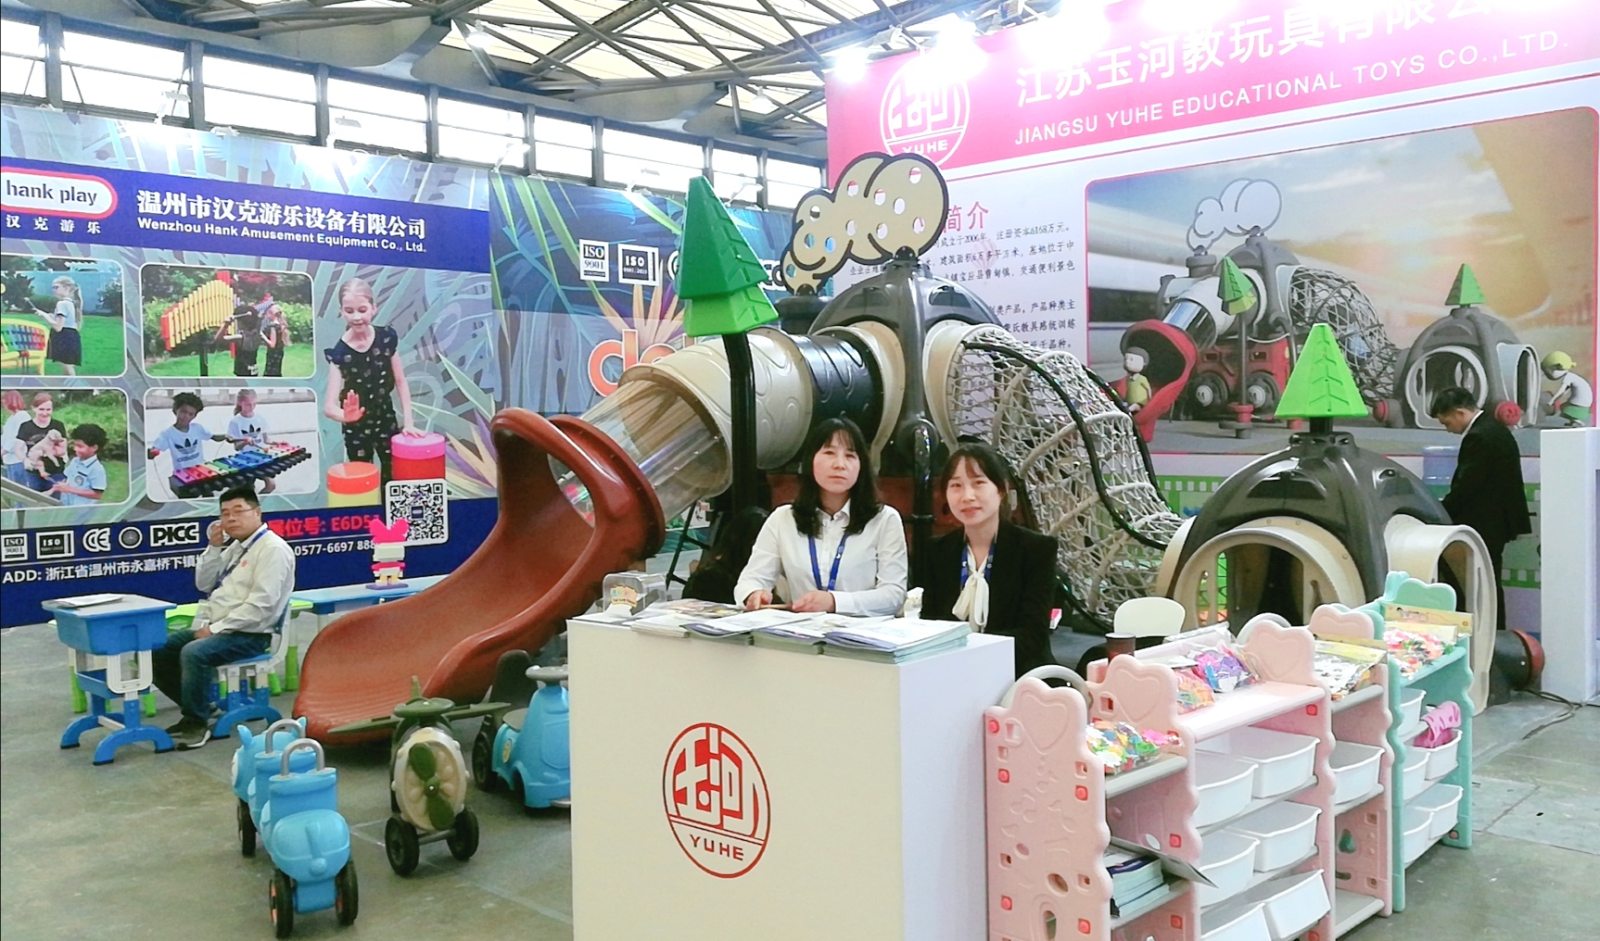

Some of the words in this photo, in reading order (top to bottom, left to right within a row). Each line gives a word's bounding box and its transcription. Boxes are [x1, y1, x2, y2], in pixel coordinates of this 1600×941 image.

[1015, 115, 1099, 146] JIANGSU
[1106, 103, 1164, 129] YUHE
[1172, 73, 1342, 116] EDUCATIONAL
[1353, 55, 1426, 85] TOYS
[6, 180, 55, 200] hank
[60, 185, 98, 206] play
[136, 189, 427, 240] 温州市汉克游乐设备有限公司
[6, 214, 102, 235] 汉克游乐
[137, 217, 202, 234] Wenzhou
[204, 223, 239, 237] Hank
[241, 226, 315, 244] Amusement
[317, 233, 379, 249] Equipment
[405, 241, 428, 253] Ltd.
[584, 245, 605, 259] ISO
[625, 255, 645, 267] ISO
[331, 514, 380, 532] E6D5
[5, 537, 24, 547] ISO
[42, 538, 61, 547] ISO
[151, 522, 200, 547] PICC
[295, 541, 354, 557] 0577-6697
[2, 569, 42, 584] ADD:
[689, 833, 746, 862] YUHE
